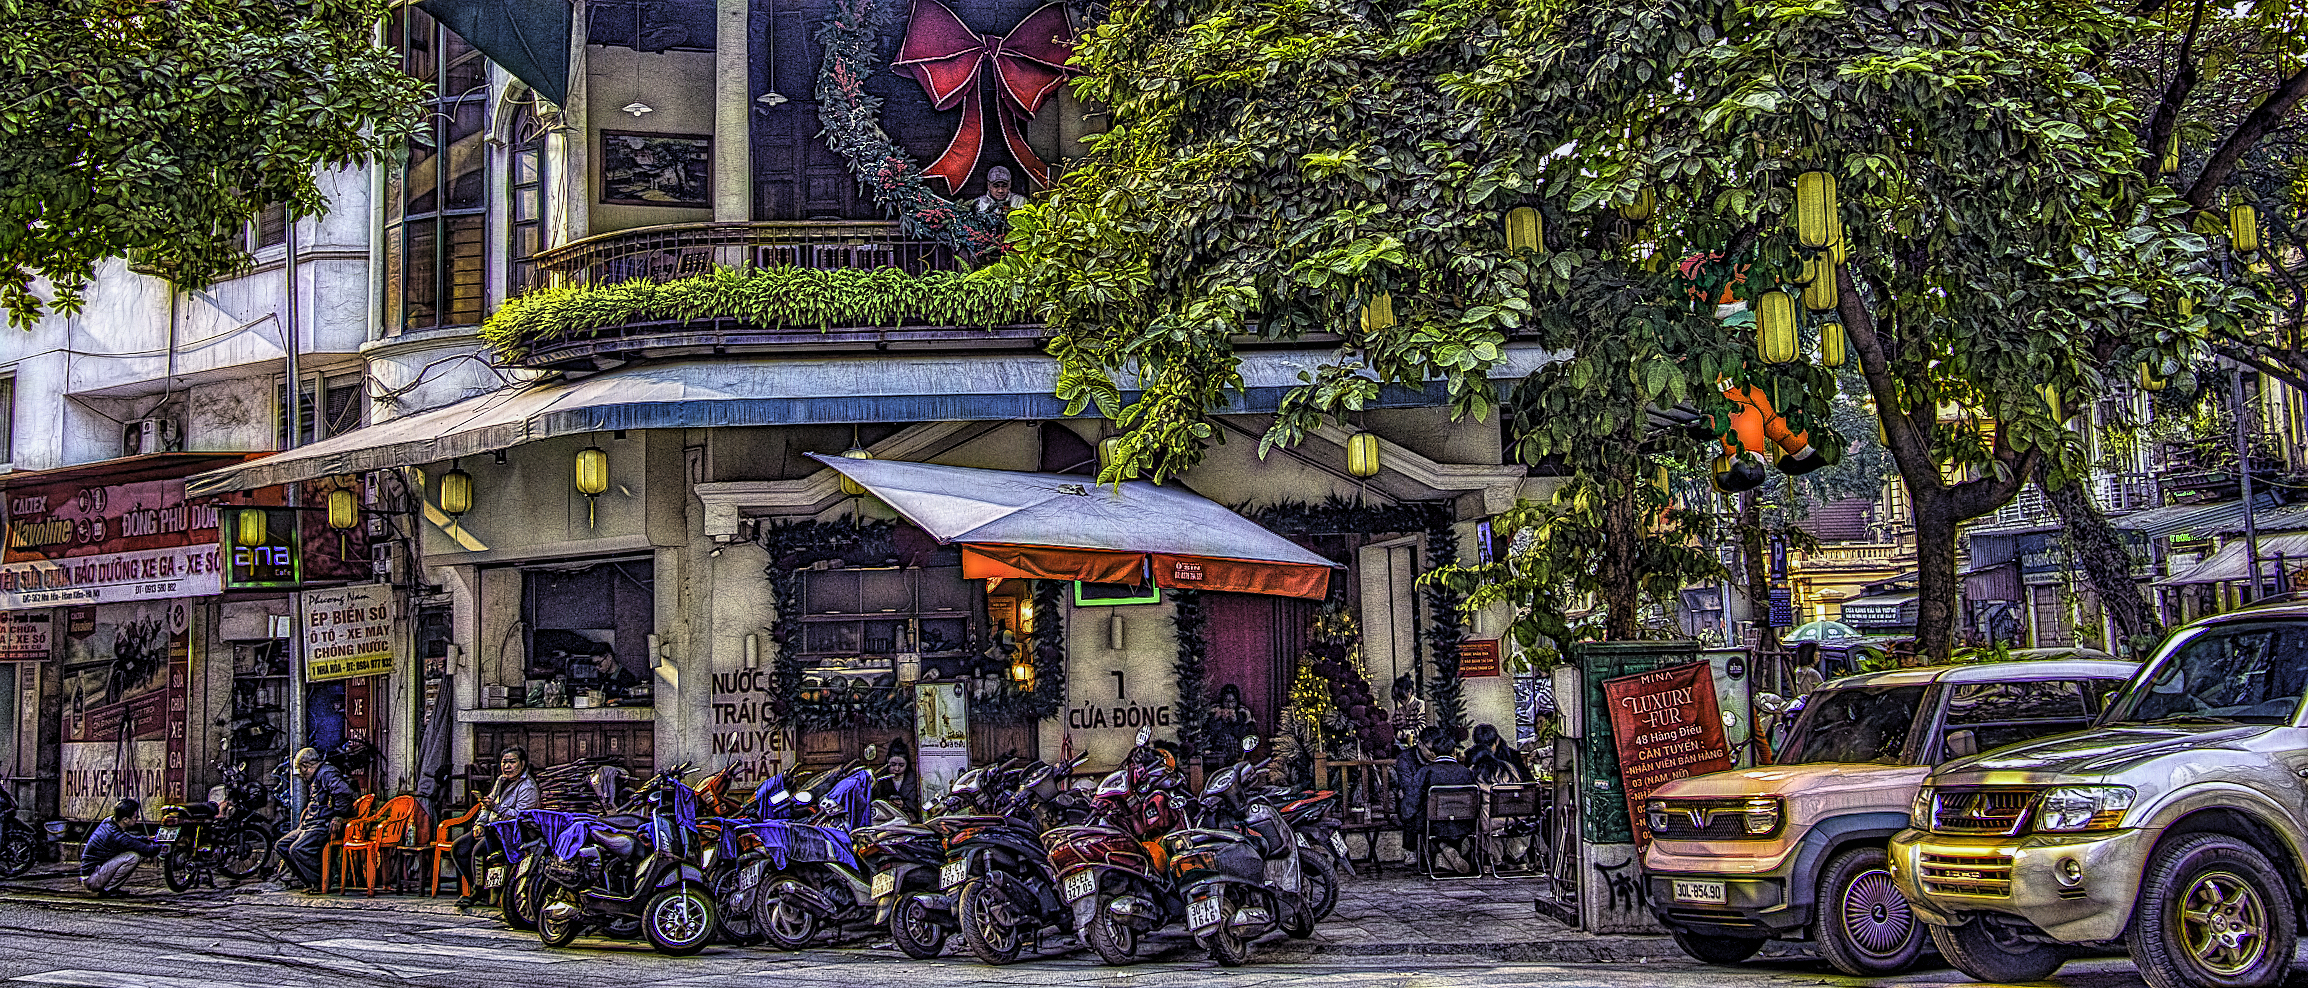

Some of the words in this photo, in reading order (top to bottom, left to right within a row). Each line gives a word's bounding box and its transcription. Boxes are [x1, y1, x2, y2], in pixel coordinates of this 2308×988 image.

[13, 496, 48, 515] CALTEX
[192, 498, 219, 530] DOÃ
[11, 516, 74, 548] Havoline
[141, 558, 157, 579] XE
[159, 556, 175, 577] GA
[186, 554, 203, 575] XE
[310, 609, 328, 628] ÉP
[332, 603, 365, 625] BIỂN
[369, 600, 388, 621] SỐ
[17, 634, 29, 644] XE
[33, 631, 46, 644] SỐ
[321, 628, 336, 642] TÔ
[347, 627, 362, 640] XE
[314, 641, 355, 659] CHỐNG
[357, 638, 389, 655] NƯỚC
[1111, 671, 1125, 699] 1
[1640, 671, 1674, 685] MINA
[353, 698, 363, 716] XE
[1621, 686, 1694, 715] LUXURY
[712, 697, 757, 725] TRÁI
[1069, 700, 1108, 729] CỬA
[1112, 700, 1170, 729] ĐÔNG
[1641, 707, 1683, 728] FUR
[170, 721, 183, 739] XE
[1635, 734, 1649, 746] 48
[1650, 730, 1678, 743] Hàng
[1638, 746, 1662, 761] CẦN
[1662, 738, 1699, 756] TUYỂN
[1655, 757, 1676, 769] VIÊN
[1677, 754, 1697, 766] BÁN
[1697, 749, 1724, 761] HÀNG
[92, 769, 108, 798] XE
[168, 781, 182, 799] XE
[1632, 778, 1643, 788] 03
[1066, 880, 1093, 900] 327.05
[1677, 883, 1722, 899] 30L-854.90
